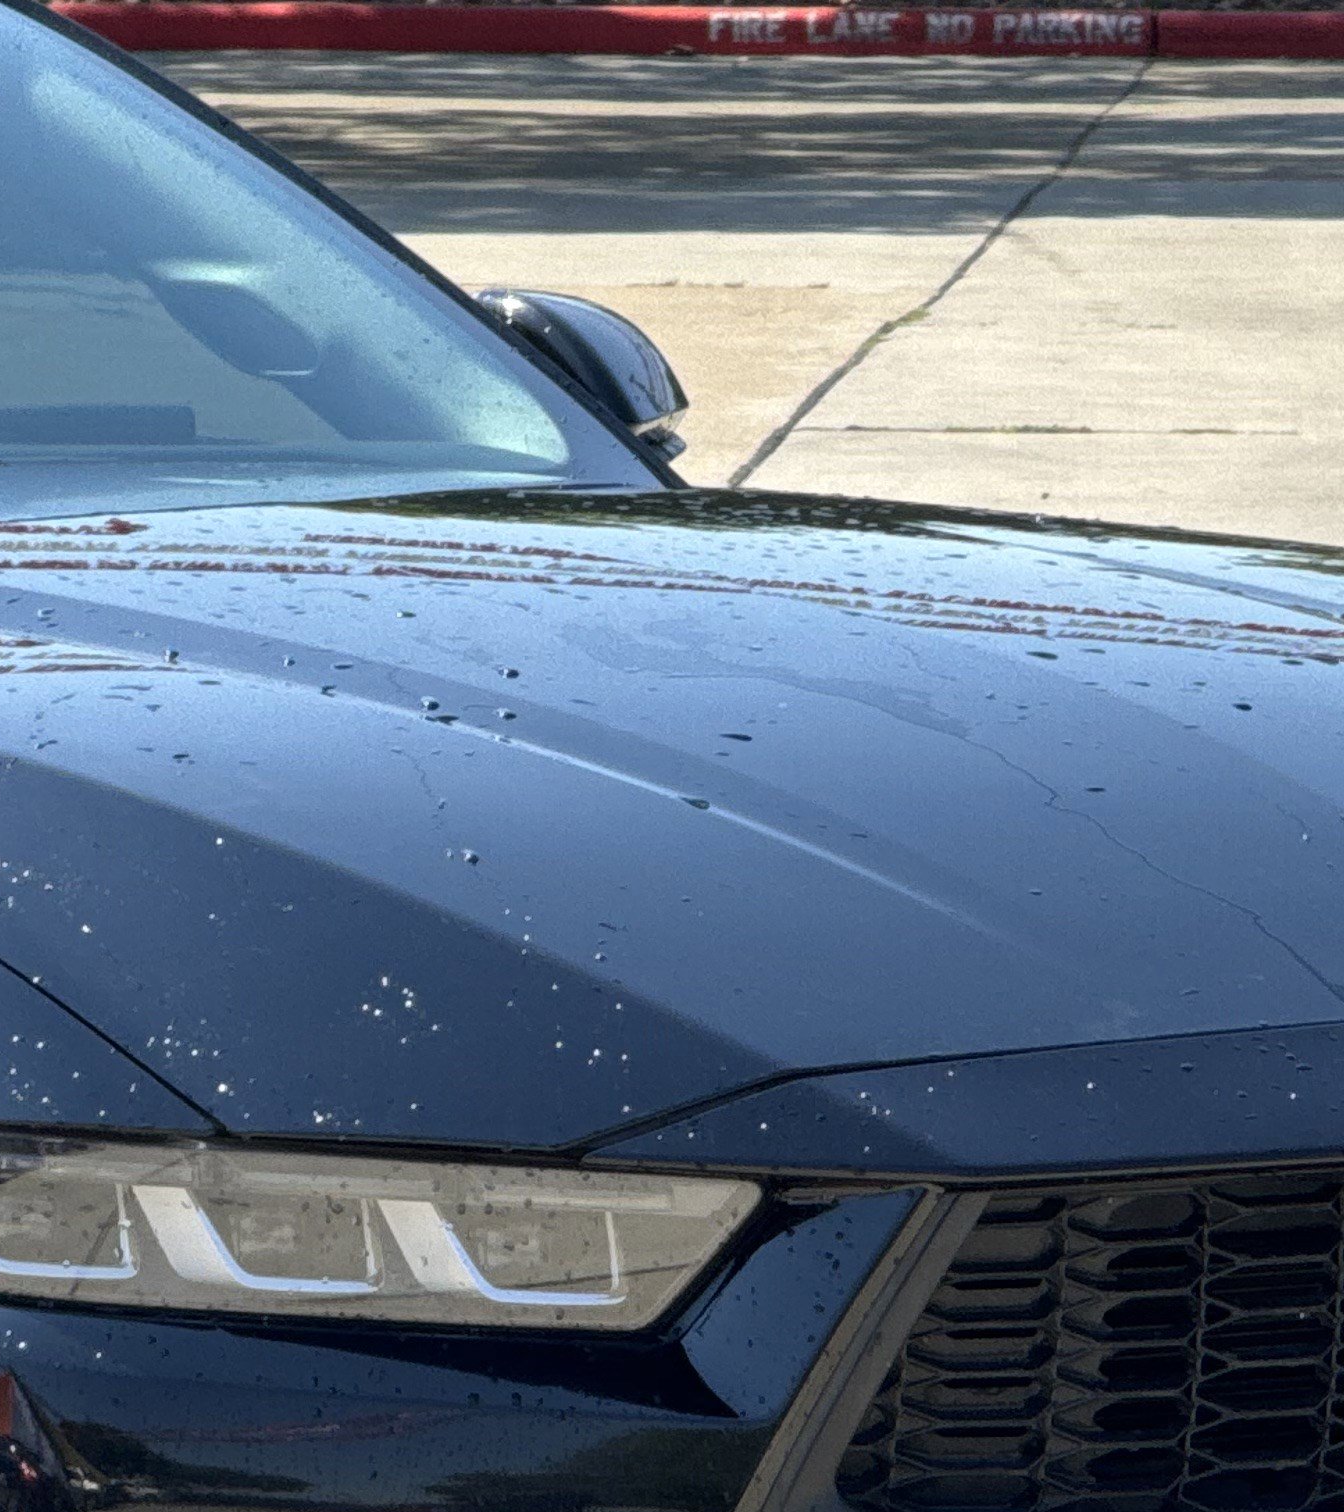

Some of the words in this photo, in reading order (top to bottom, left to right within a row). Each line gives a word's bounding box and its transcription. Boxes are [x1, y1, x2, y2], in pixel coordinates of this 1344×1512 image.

[708, 12, 787, 43] FIRE
[806, 12, 901, 43] LANE
[923, 12, 975, 42] NO
[992, 12, 1144, 43] PARKING
